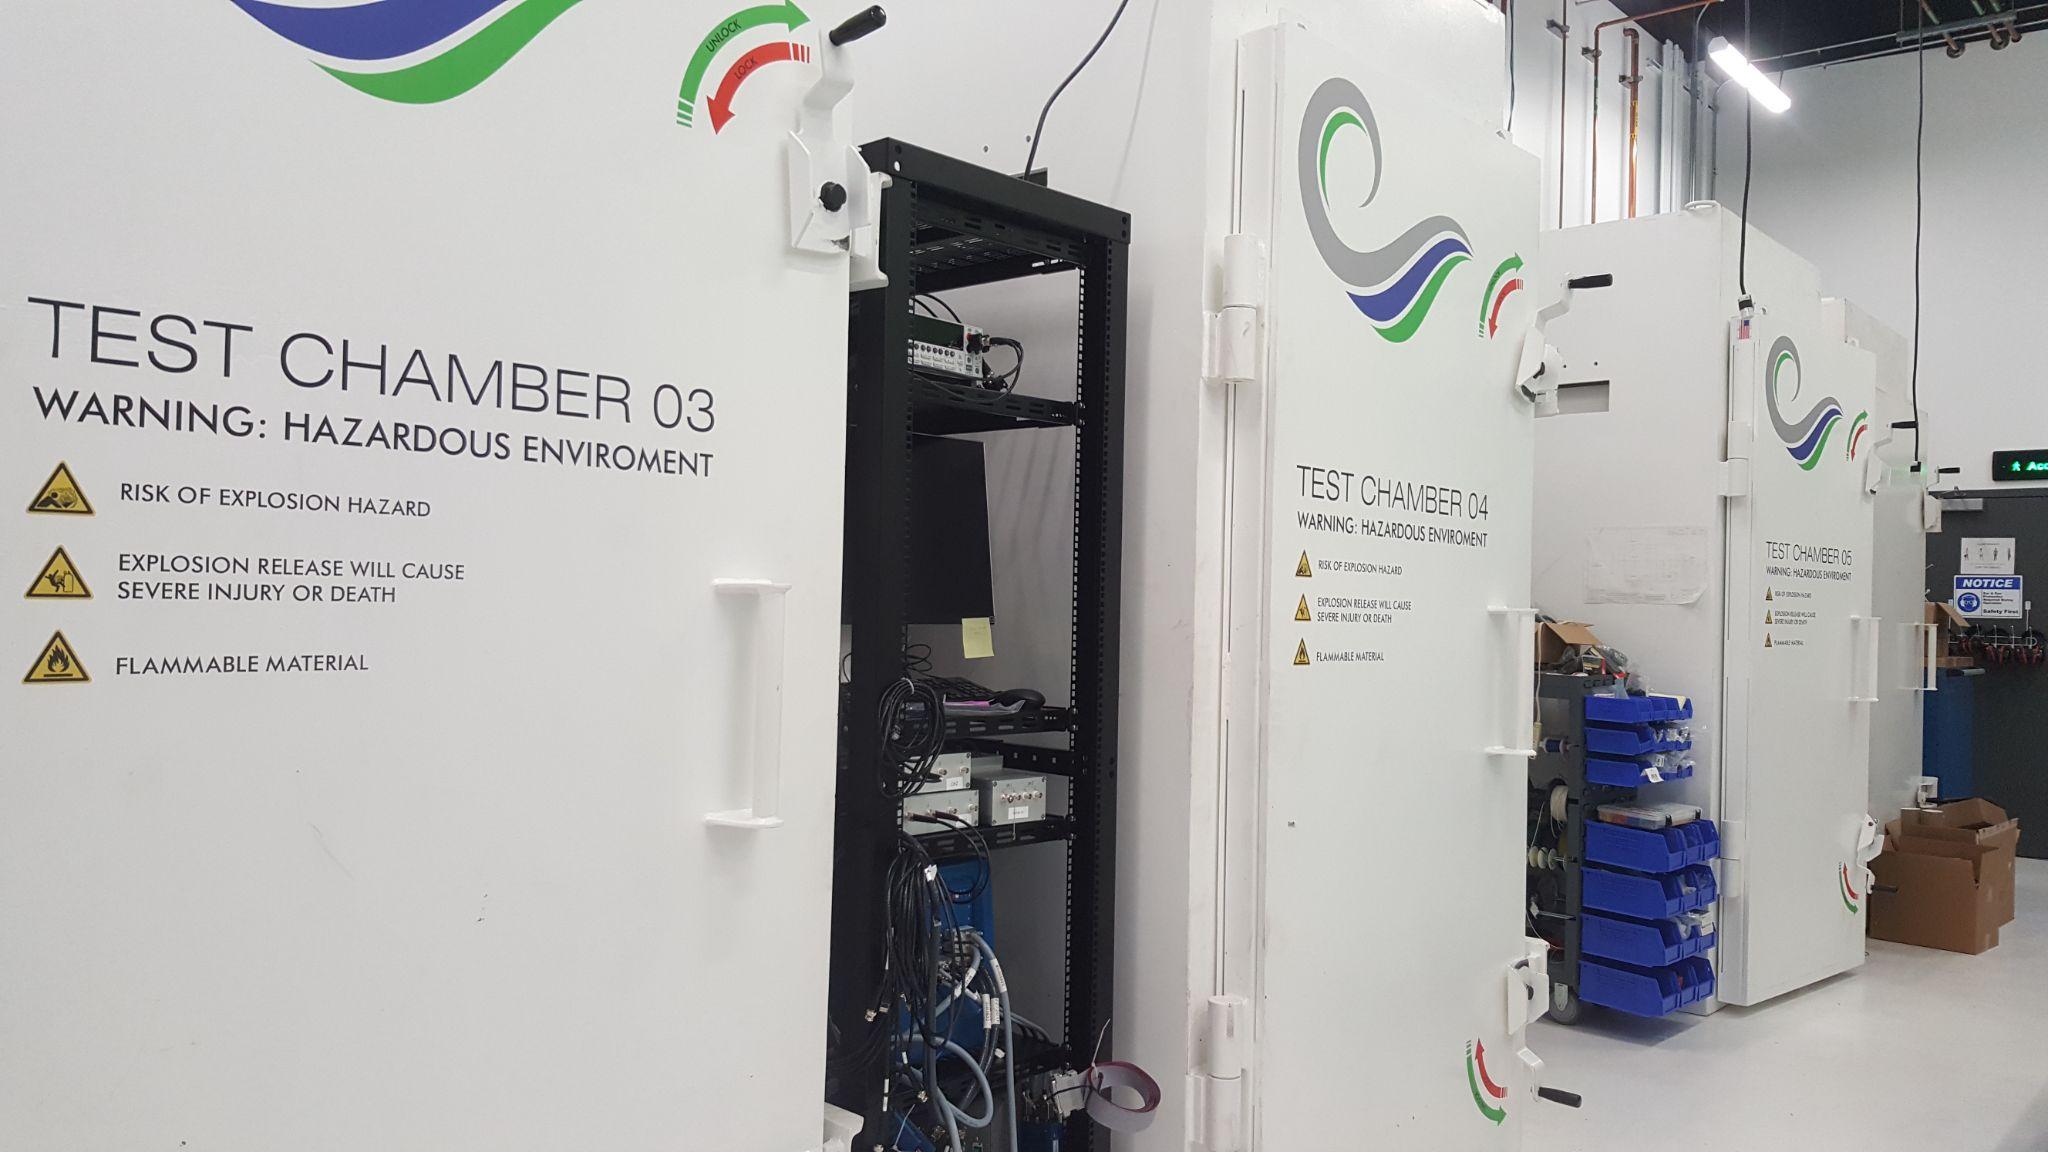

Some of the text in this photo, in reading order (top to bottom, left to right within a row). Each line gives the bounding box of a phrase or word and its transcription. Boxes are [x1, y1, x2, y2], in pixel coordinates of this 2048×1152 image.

[705, 18, 742, 53] UNLOCK
[733, 56, 759, 81] LOCK
[28, 297, 714, 432] TEST CHAMBER 03
[33, 387, 713, 476] WARNING: HAZARDOUS ENVIROMENT
[121, 483, 430, 516] RISK OF EXPLOSION HAZARD
[1297, 465, 1488, 520] TEST CHAMBER 04
[1298, 512, 1487, 547] WARNING: HAZARDOUS ENVIROMENT
[1766, 541, 1852, 565] TEST CHAMBER 05
[120, 554, 464, 579] EXPLOSION RELEASE WILL CAUSE
[1319, 560, 1402, 575] RISK OF EXPLOSION HAZARD
[118, 582, 395, 602] SEVERE INJURY OR DEATH
[1962, 578, 2014, 588] NOTICE
[1318, 598, 1411, 610] EXPLOSION RELEASE WILL CAUSE
[1318, 612, 1391, 623] SEVERE INJURY OR DEATH
[117, 655, 368, 674] FLAMMABLE MATERIAL
[1317, 652, 1384, 661] FLAMMABLE MATERIAL
